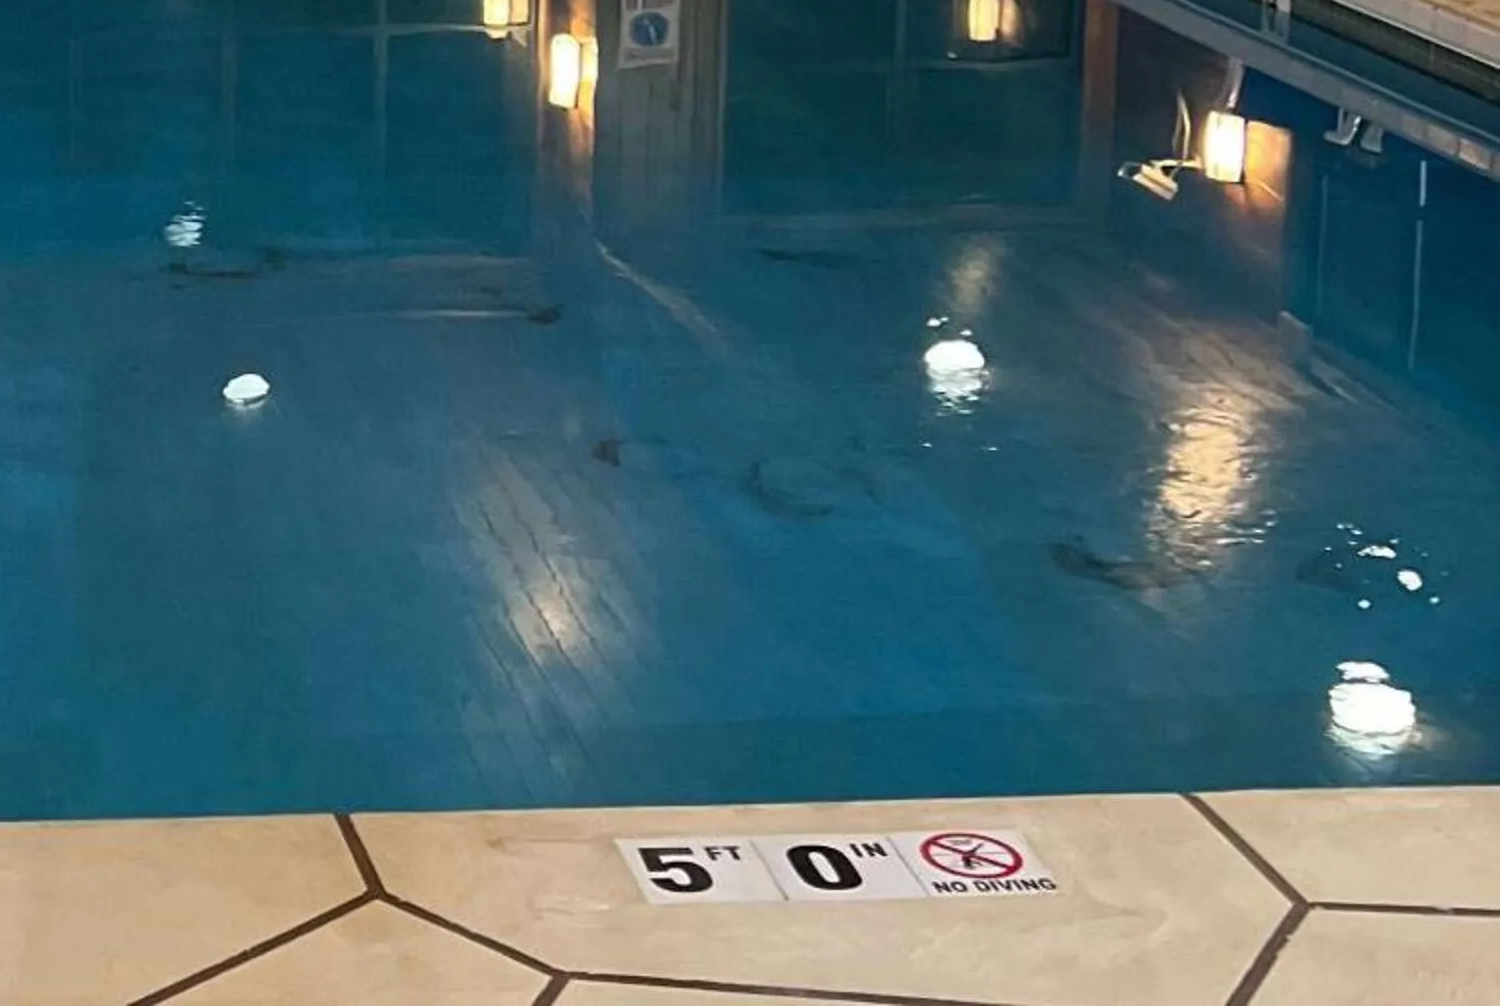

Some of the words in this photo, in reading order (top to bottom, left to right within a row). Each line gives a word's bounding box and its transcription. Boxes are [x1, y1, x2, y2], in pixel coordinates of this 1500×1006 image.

[638, 846, 713, 892] 5
[704, 846, 741, 861] FT
[786, 845, 863, 890] 0
[850, 843, 888, 857] IN
[932, 881, 968, 893] NO
[972, 877, 1057, 892] DIVING
